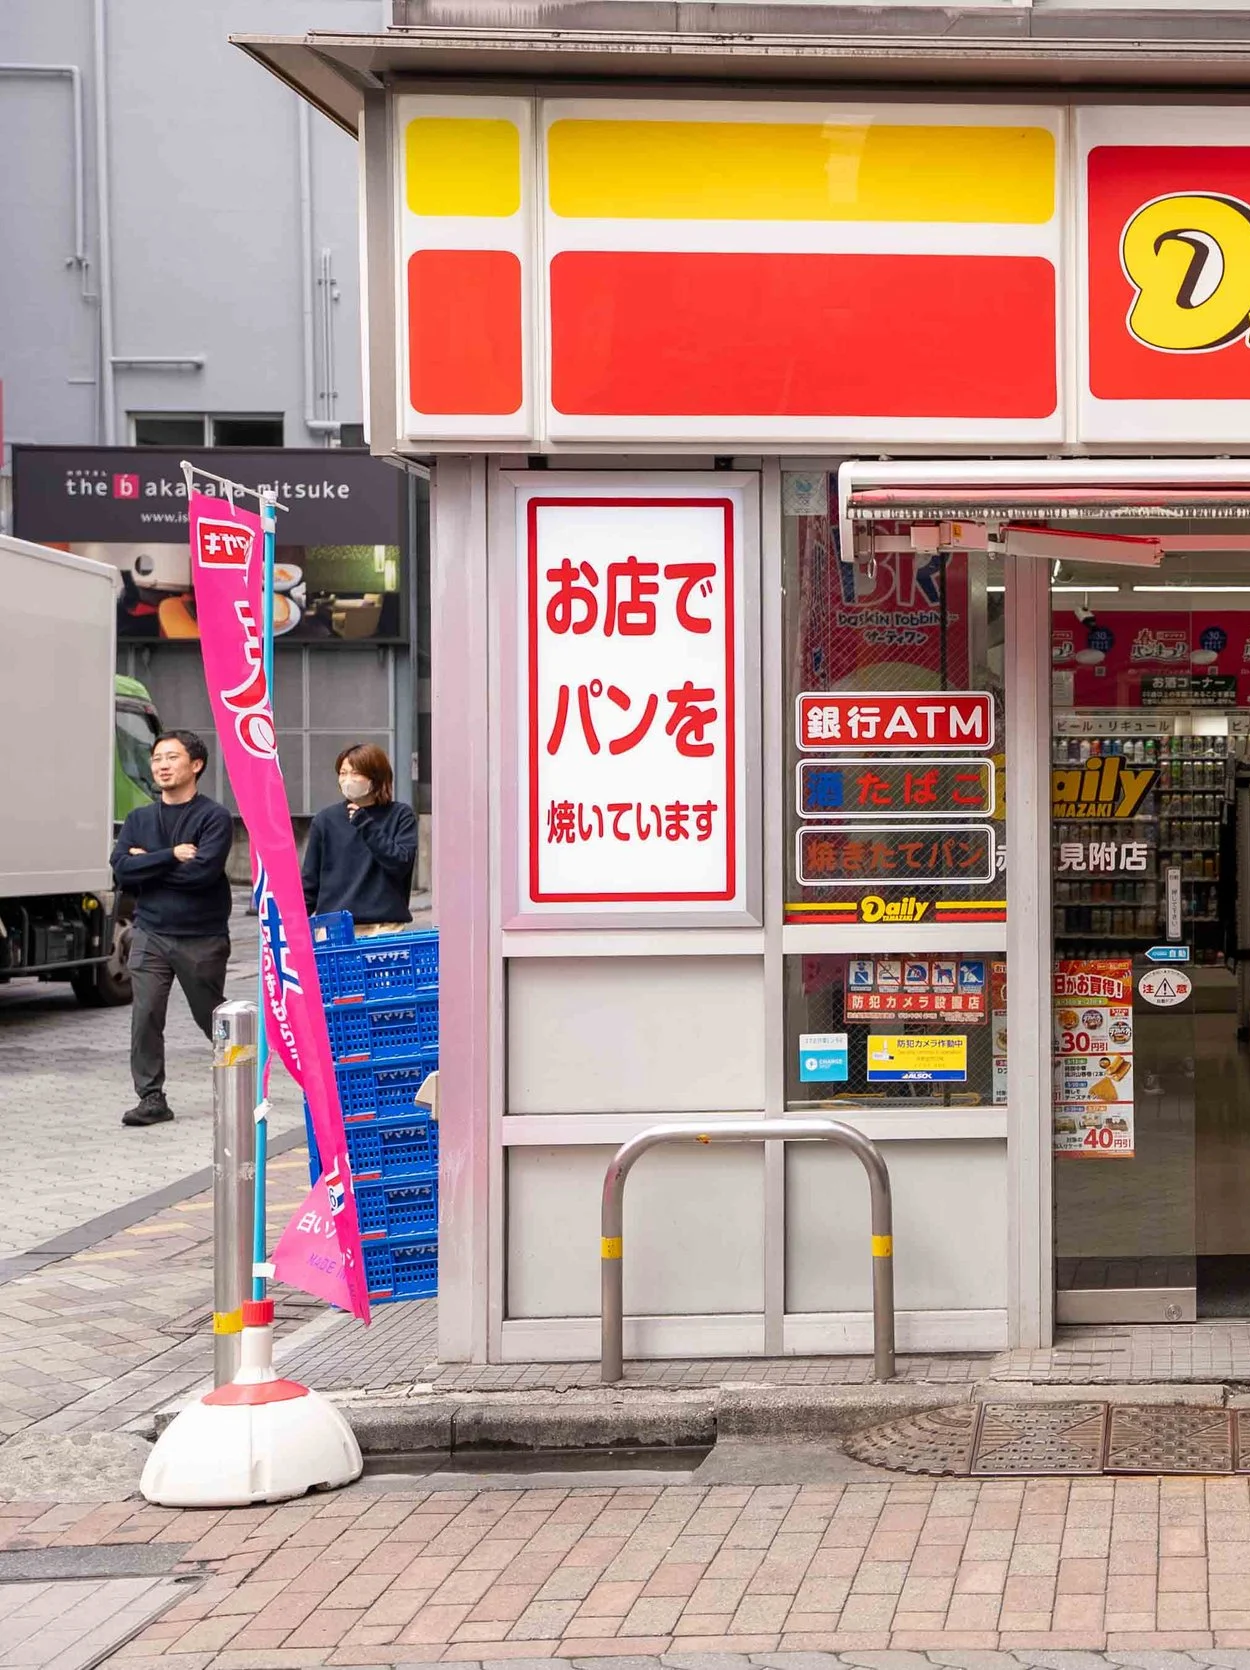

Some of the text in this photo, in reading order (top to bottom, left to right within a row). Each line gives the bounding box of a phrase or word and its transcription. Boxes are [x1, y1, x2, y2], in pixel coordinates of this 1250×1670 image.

[66, 479, 107, 496] the
[545, 556, 717, 637] お店で
[895, 610, 959, 626] robbin
[1152, 677, 1226, 689] お酒コーナー
[546, 679, 718, 758] パンを
[807, 705, 983, 739] 銀行ATM
[807, 769, 984, 807] 酒 たばこ
[546, 799, 719, 843] 焼いています
[806, 836, 986, 872] 焼きたてパン
[861, 896, 929, 922] Daily
[365, 951, 410, 963] ヤマザキ
[1143, 984, 1188, 994] 注 意
[852, 995, 980, 1009] 防犯カメラ設置店
[897, 1039, 963, 1048] 防犯カメラ作動中
[1061, 1032, 1109, 1053] 30円引
[1083, 1128, 1131, 1149] 40円引
